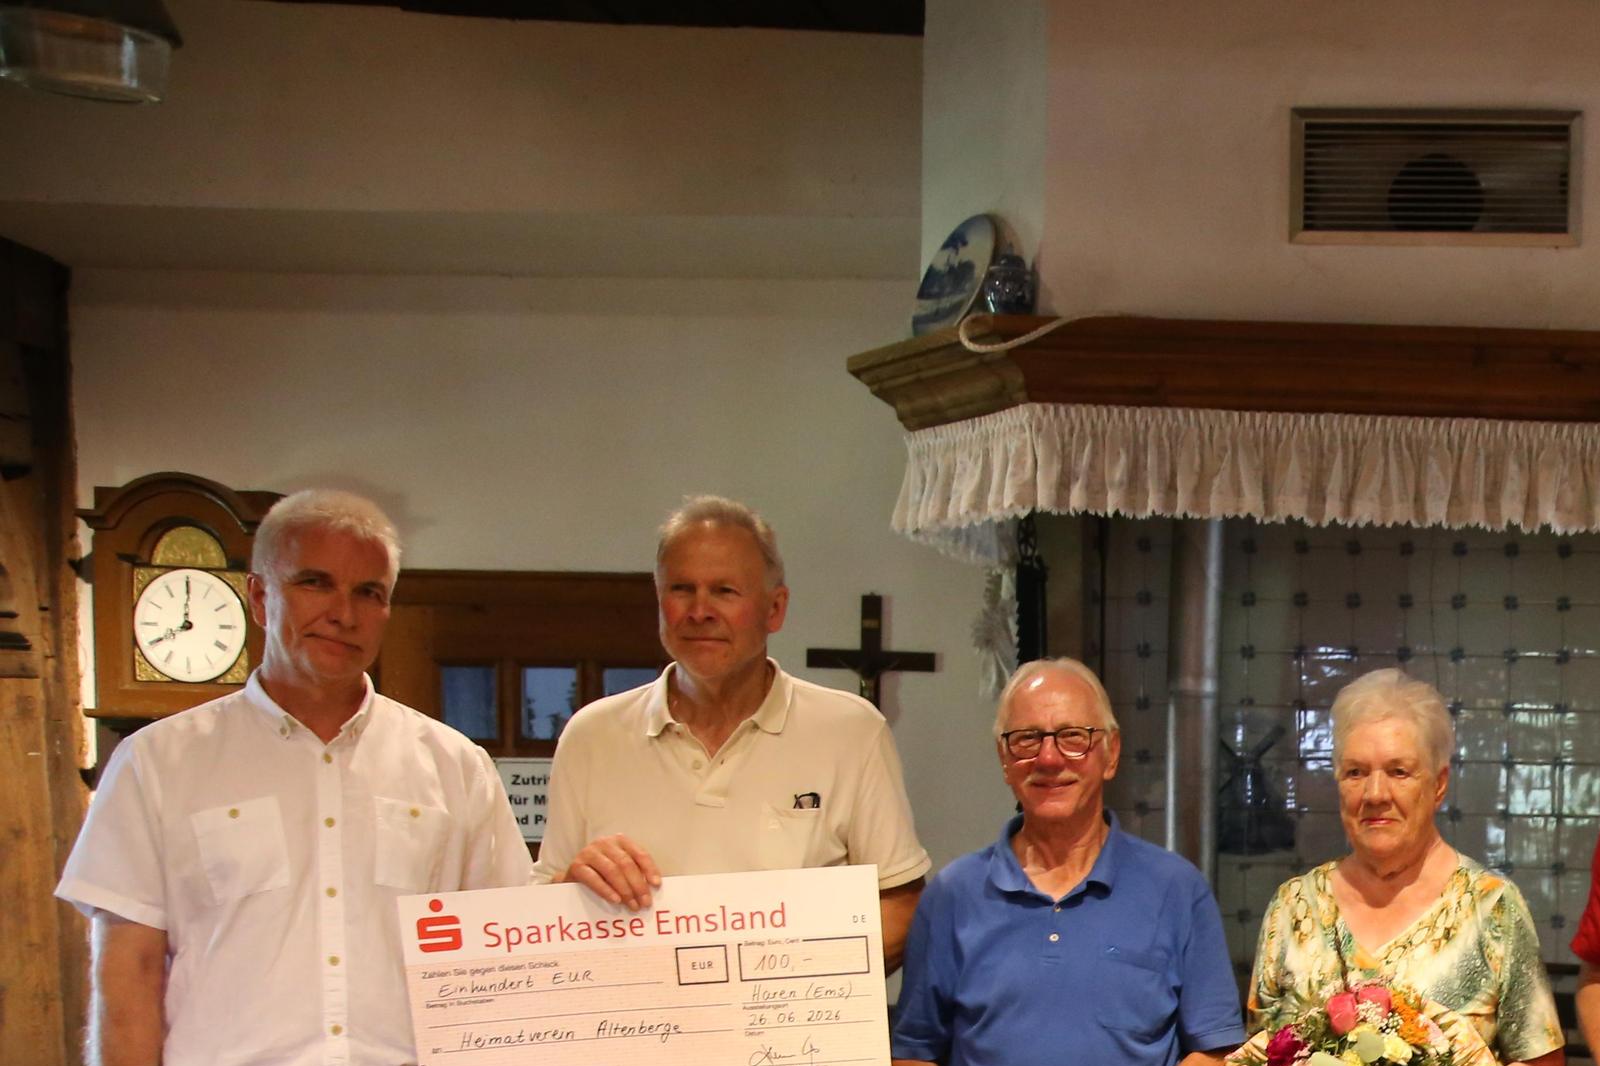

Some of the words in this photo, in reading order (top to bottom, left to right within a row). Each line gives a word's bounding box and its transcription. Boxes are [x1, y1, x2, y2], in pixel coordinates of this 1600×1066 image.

[483, 914, 646, 952] Sparkasse
[655, 902, 787, 937] Emsland
[691, 960, 714, 971] EUR
[438, 975, 534, 998] Einhundert
[551, 969, 595, 985] EUR
[752, 982, 797, 1002] Haren
[805, 979, 853, 1000] (Ems)
[807, 1009, 841, 1022] 2026
[459, 1029, 575, 1050] Heimatverein
[597, 1018, 683, 1042] Altenberge
